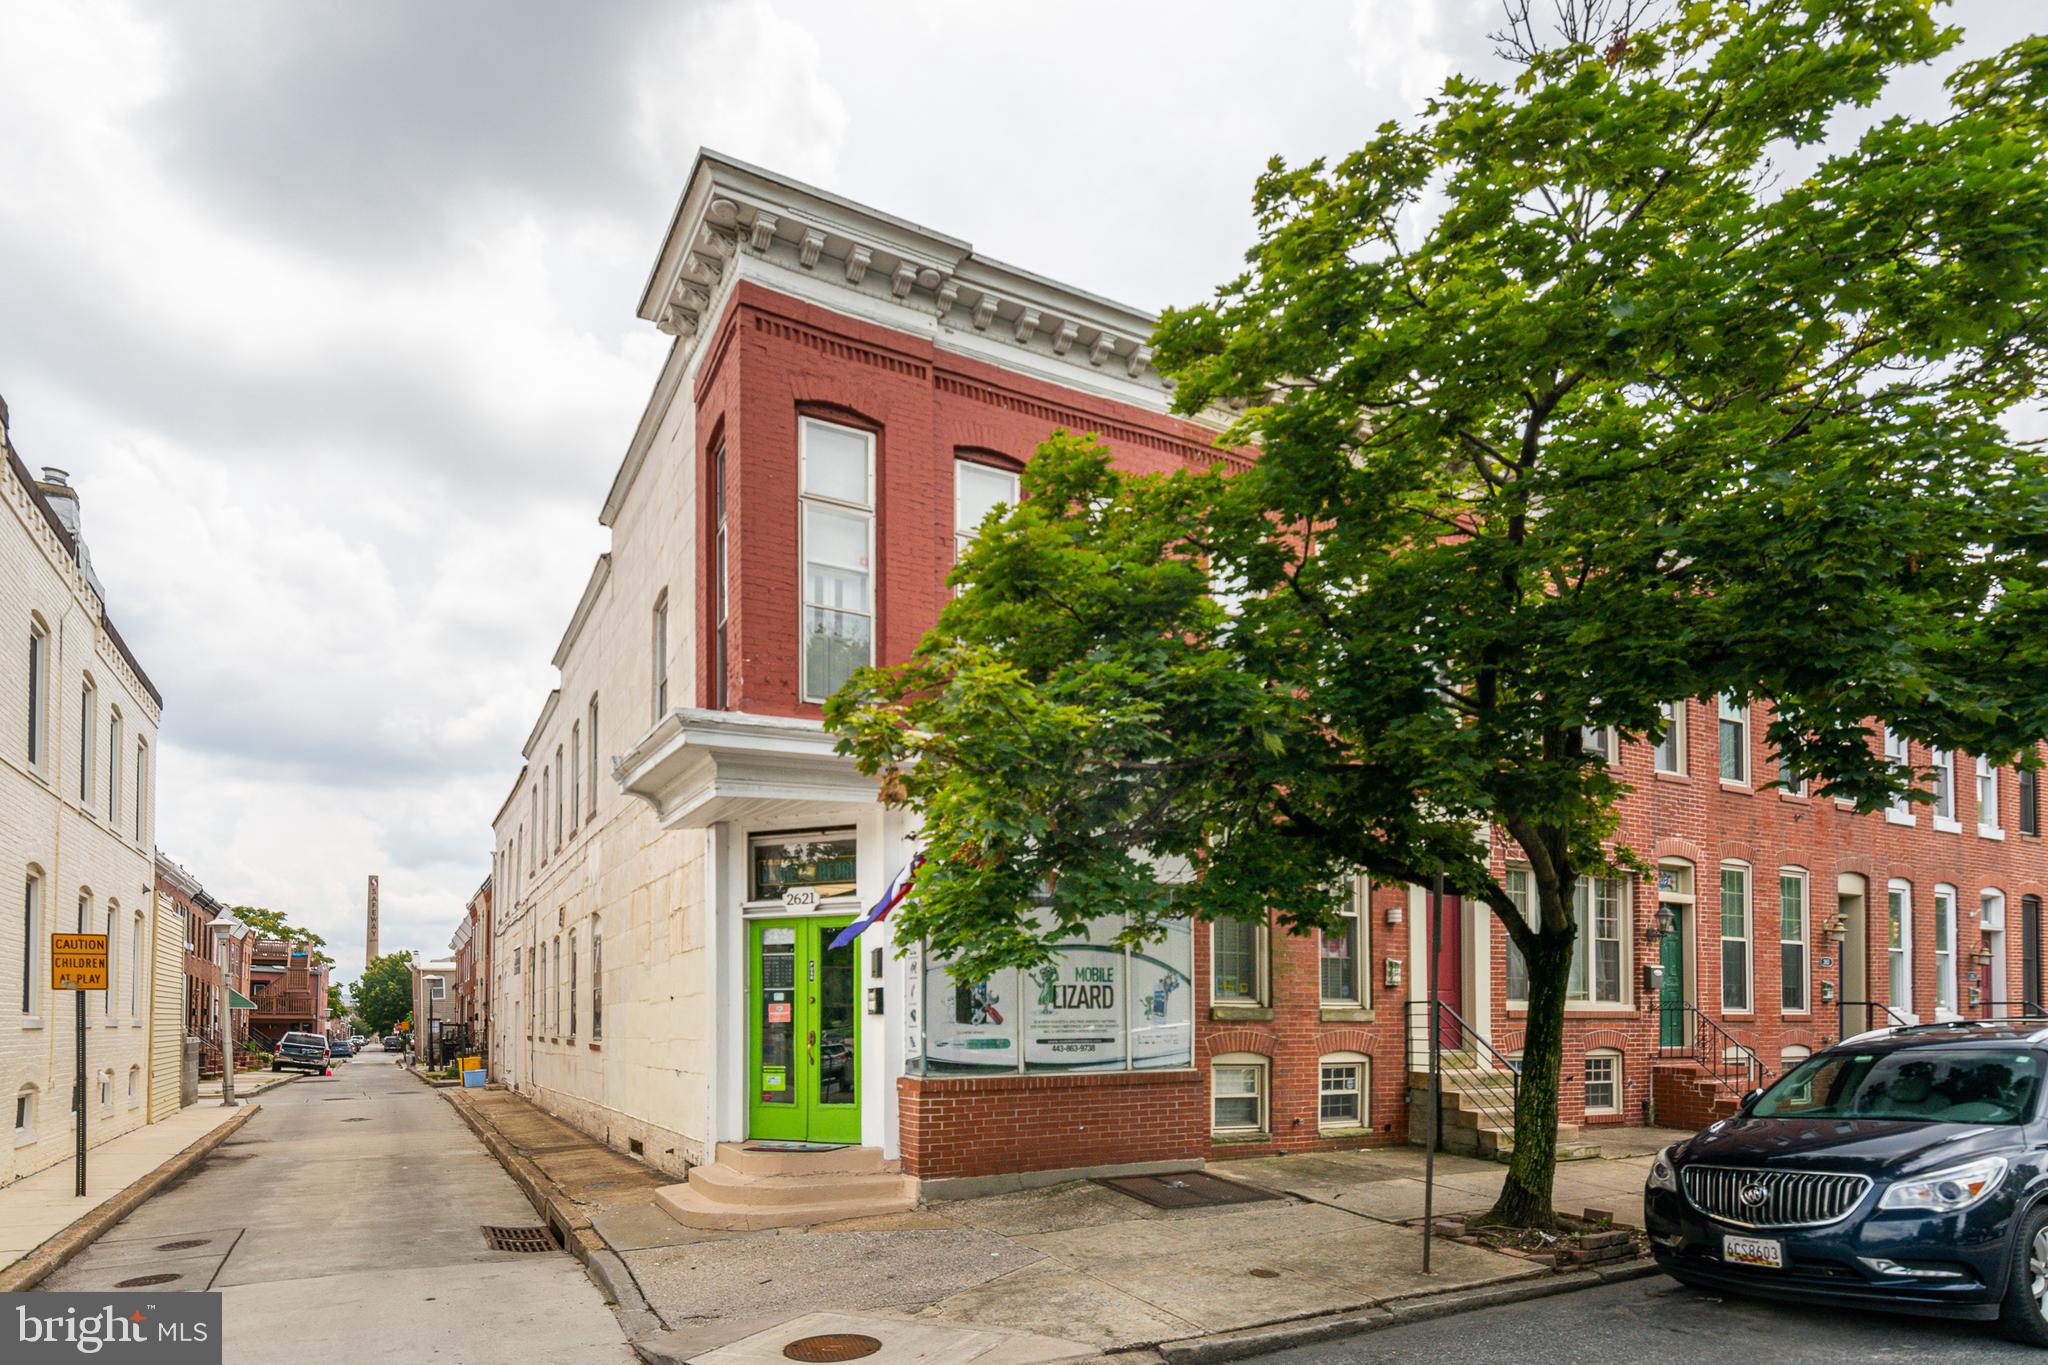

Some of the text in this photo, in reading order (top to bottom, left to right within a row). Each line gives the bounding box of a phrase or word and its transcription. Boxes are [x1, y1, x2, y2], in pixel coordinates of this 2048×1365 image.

[786, 892, 814, 906] 2621
[55, 939, 105, 950] CAUTION
[55, 958, 105, 968] CHILDREN
[60, 974, 101, 985] AT PLAY
[1075, 967, 1114, 982] MOBILE
[1053, 985, 1114, 1009] LIZARD
[1727, 1243, 1778, 1259] 6CS8603
